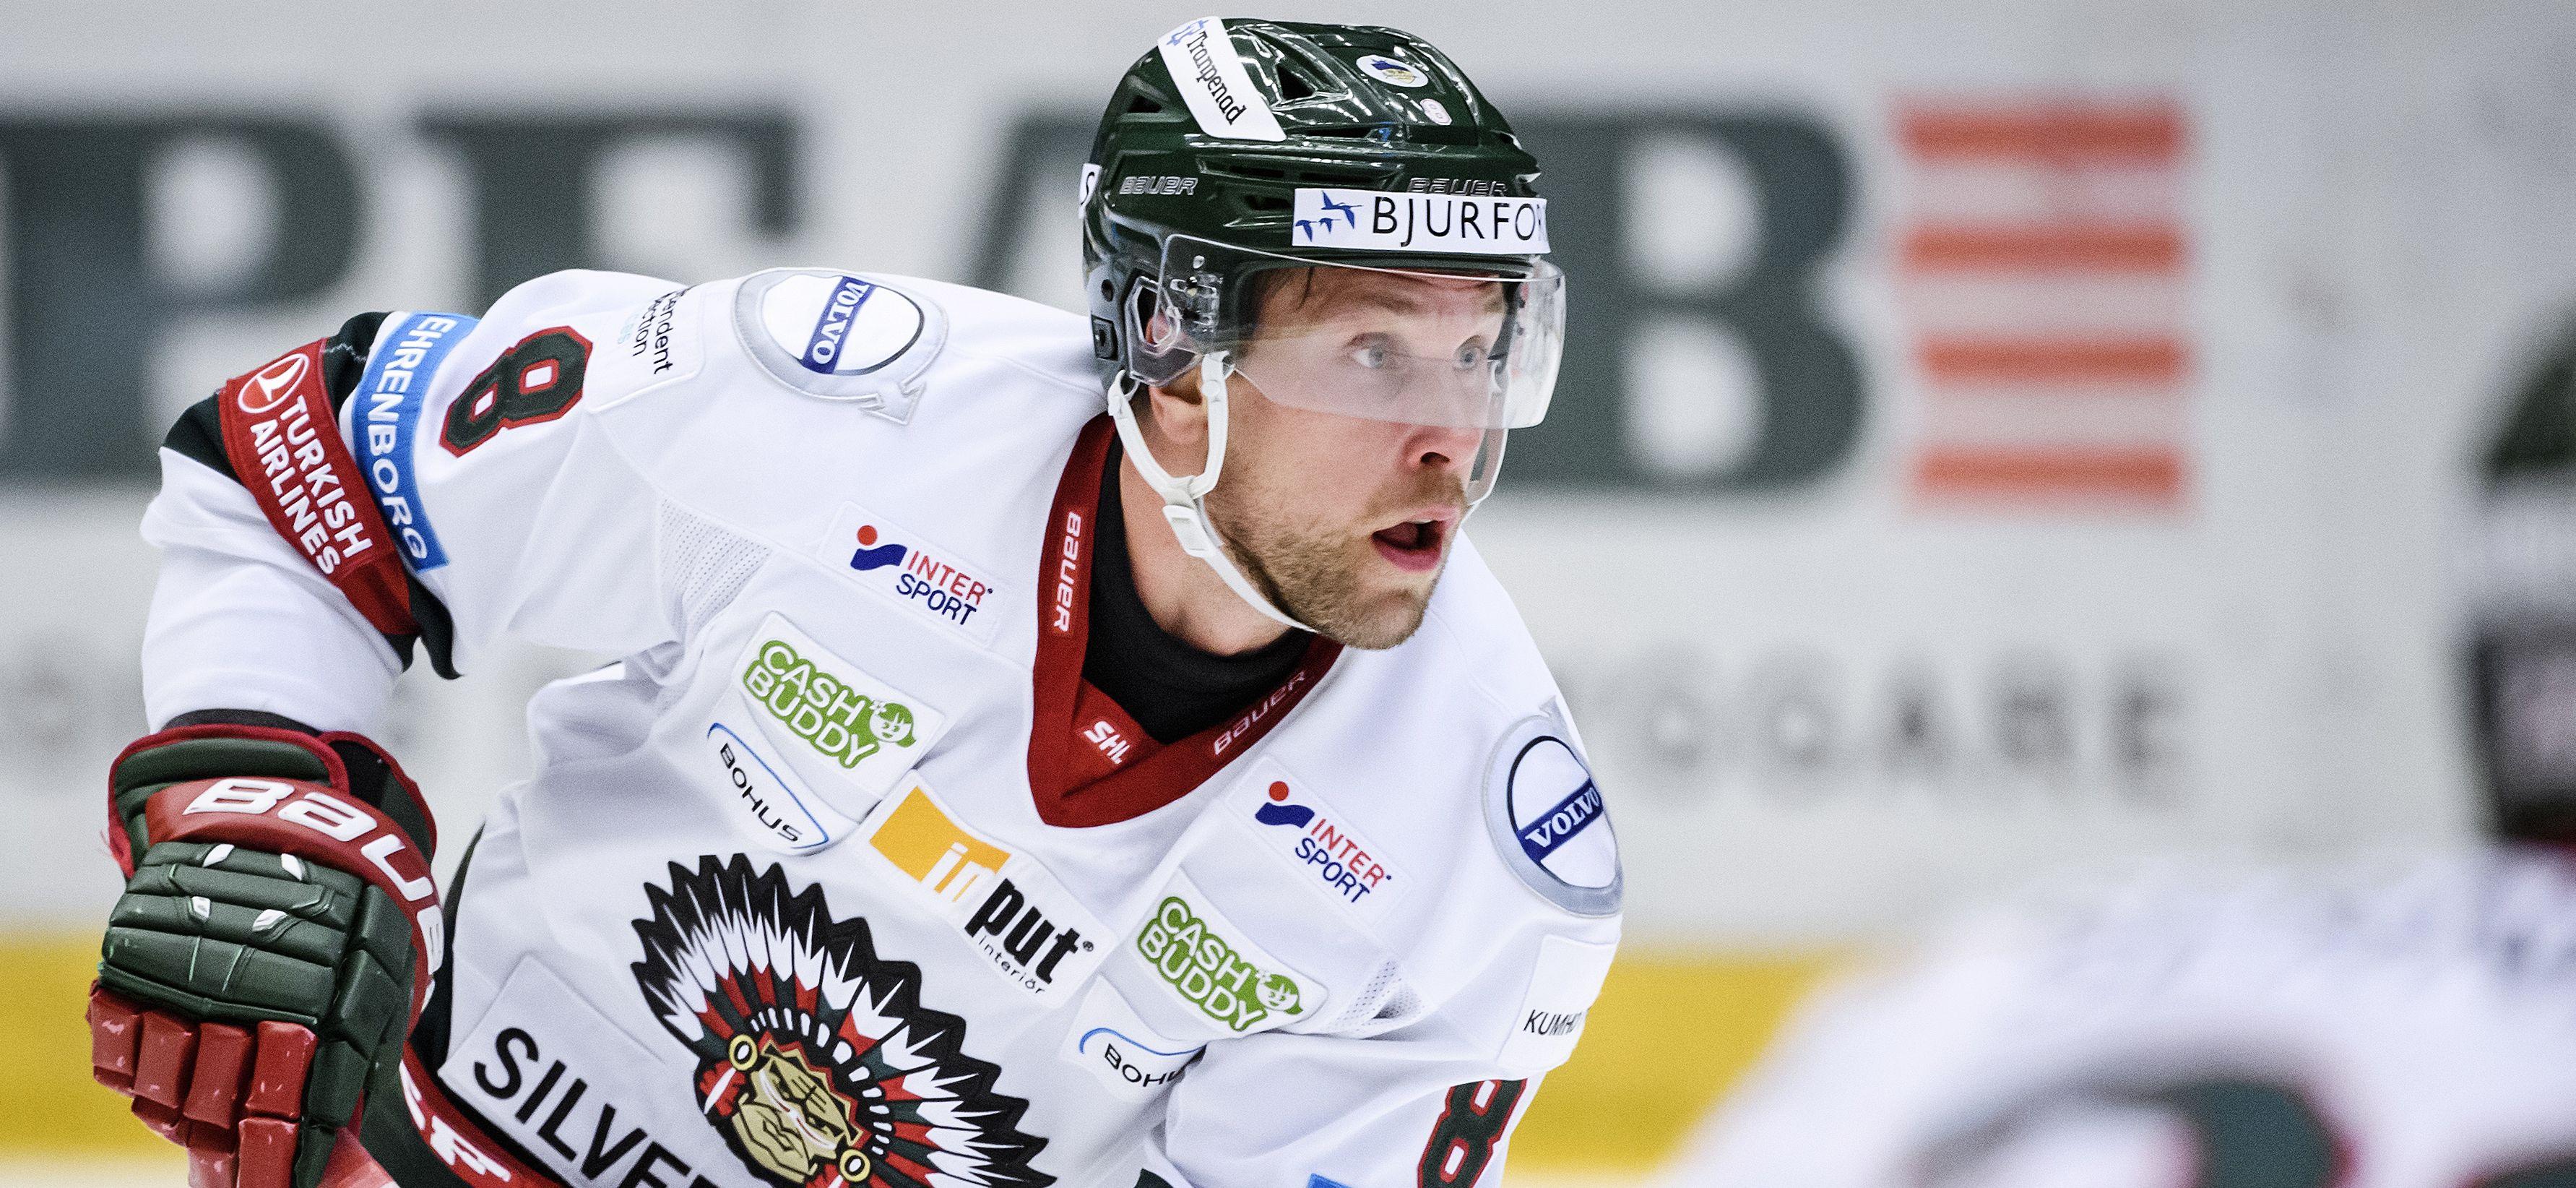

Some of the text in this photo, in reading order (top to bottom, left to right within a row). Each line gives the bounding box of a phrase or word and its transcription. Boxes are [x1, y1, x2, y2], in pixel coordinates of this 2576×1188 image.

[1187, 30, 1248, 126] Tranpenad
[812, 281, 870, 364] VOLVO
[366, 317, 457, 560] EHRENBORG
[439, 325, 593, 458] 8
[249, 419, 340, 574] AIRLINES
[280, 396, 373, 558] TURKISH
[896, 573, 977, 625] SPORT
[907, 550, 987, 606] INTER
[745, 664, 876, 766] BUDDY
[763, 645, 865, 727] CASH
[1084, 720, 1131, 765] SHL
[719, 742, 803, 842] BOHUS
[1524, 786, 1601, 848] VOLVO
[183, 778, 446, 1012] BAUE
[1295, 837, 1370, 903] SPORT
[1310, 818, 1385, 888] INTER
[1141, 924, 1264, 1029] BUDDY
[1160, 902, 1253, 992] CASH
[474, 1025, 725, 1188] SILVE
[1417, 1078, 1529, 1188] 8
